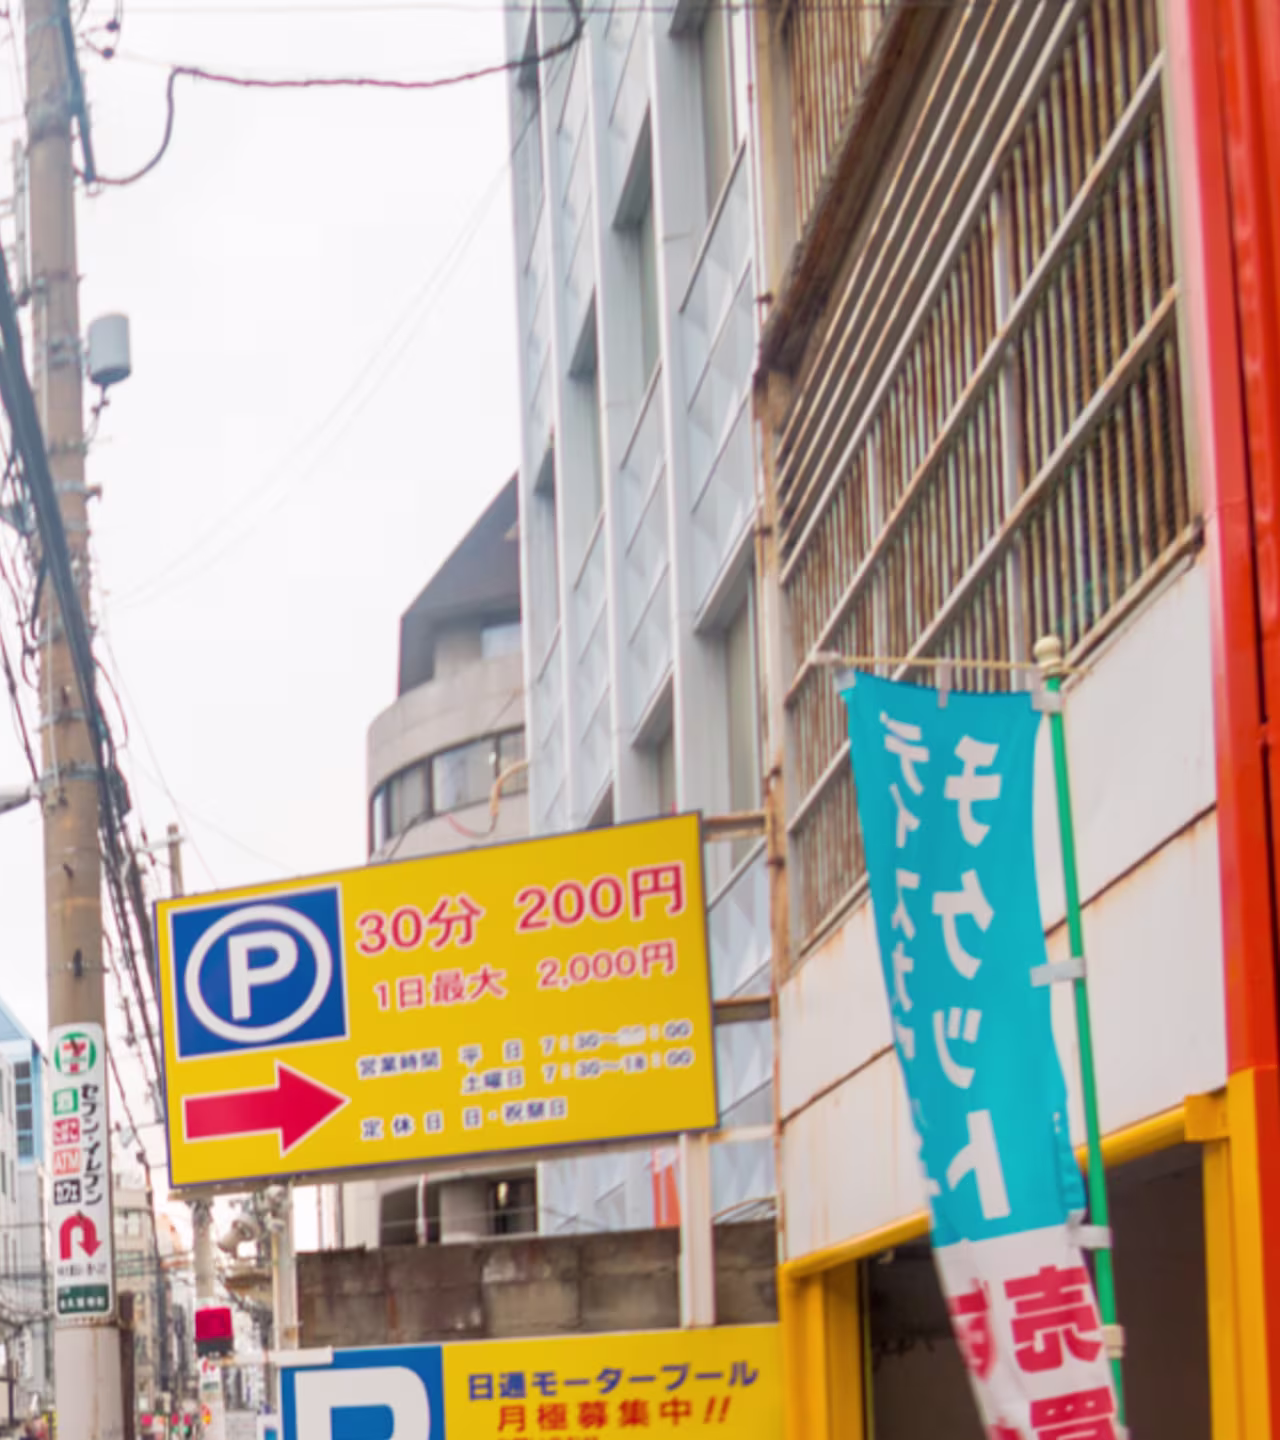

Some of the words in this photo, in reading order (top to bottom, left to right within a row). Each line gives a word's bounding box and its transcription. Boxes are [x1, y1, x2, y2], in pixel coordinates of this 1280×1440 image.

[357, 894, 483, 956] 30分
[516, 861, 684, 933] 200円
[227, 930, 299, 1020] P
[376, 966, 506, 1010] 1日最大
[538, 940, 677, 991] 2,000円
[357, 1048, 442, 1077] 営業時間
[461, 1067, 524, 1095] 土曜日
[55, 1151, 79, 1172] ATM
